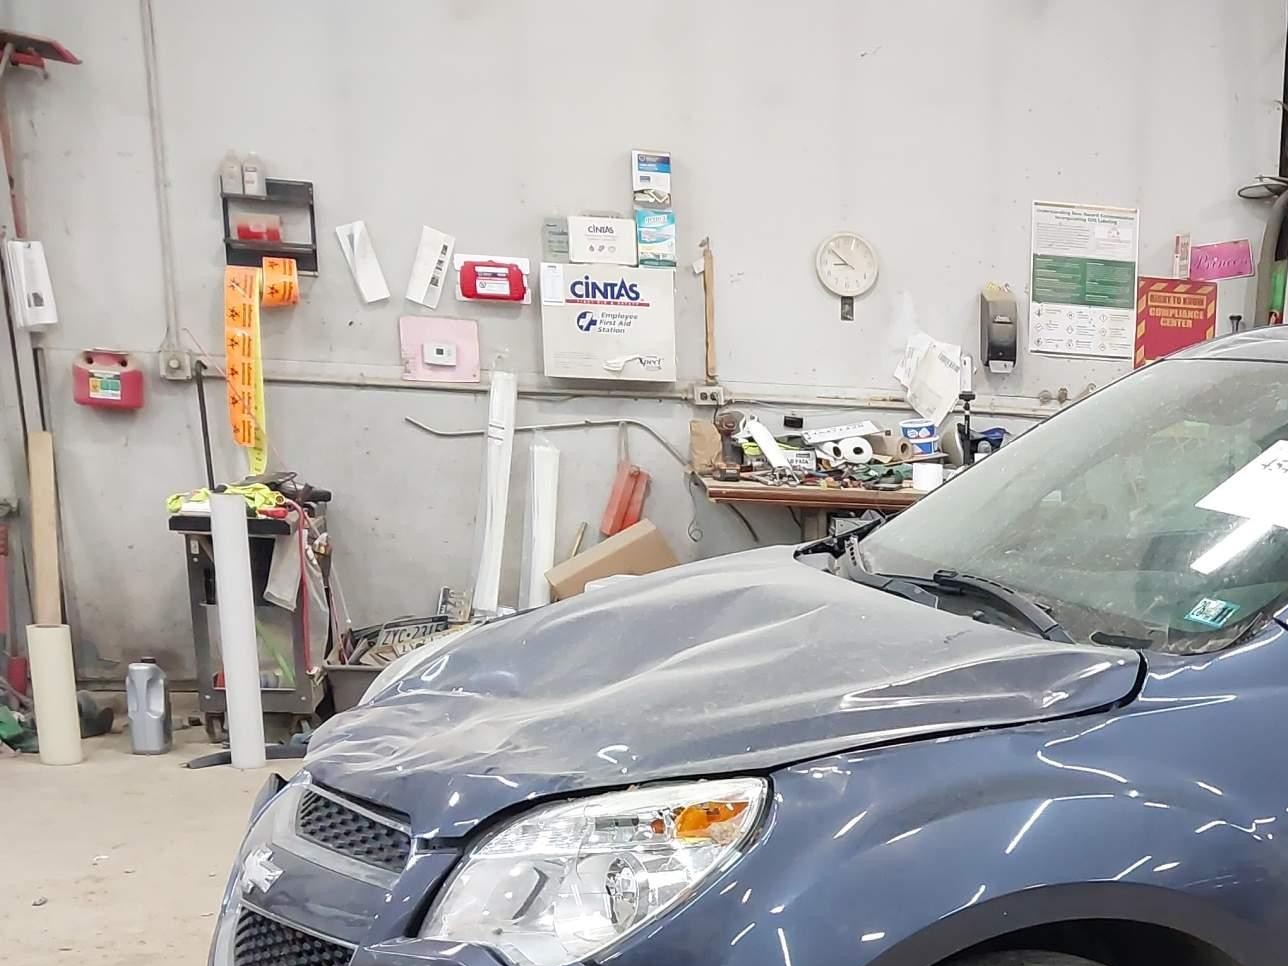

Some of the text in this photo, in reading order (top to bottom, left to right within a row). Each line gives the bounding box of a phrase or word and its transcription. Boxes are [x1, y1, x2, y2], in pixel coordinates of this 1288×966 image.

[570, 275, 641, 302] CINTAS
[601, 311, 638, 321] Employee
[1149, 307, 1204, 319] COMPLIANCE
[1160, 317, 1193, 328] CENTER
[597, 326, 625, 334] Station
